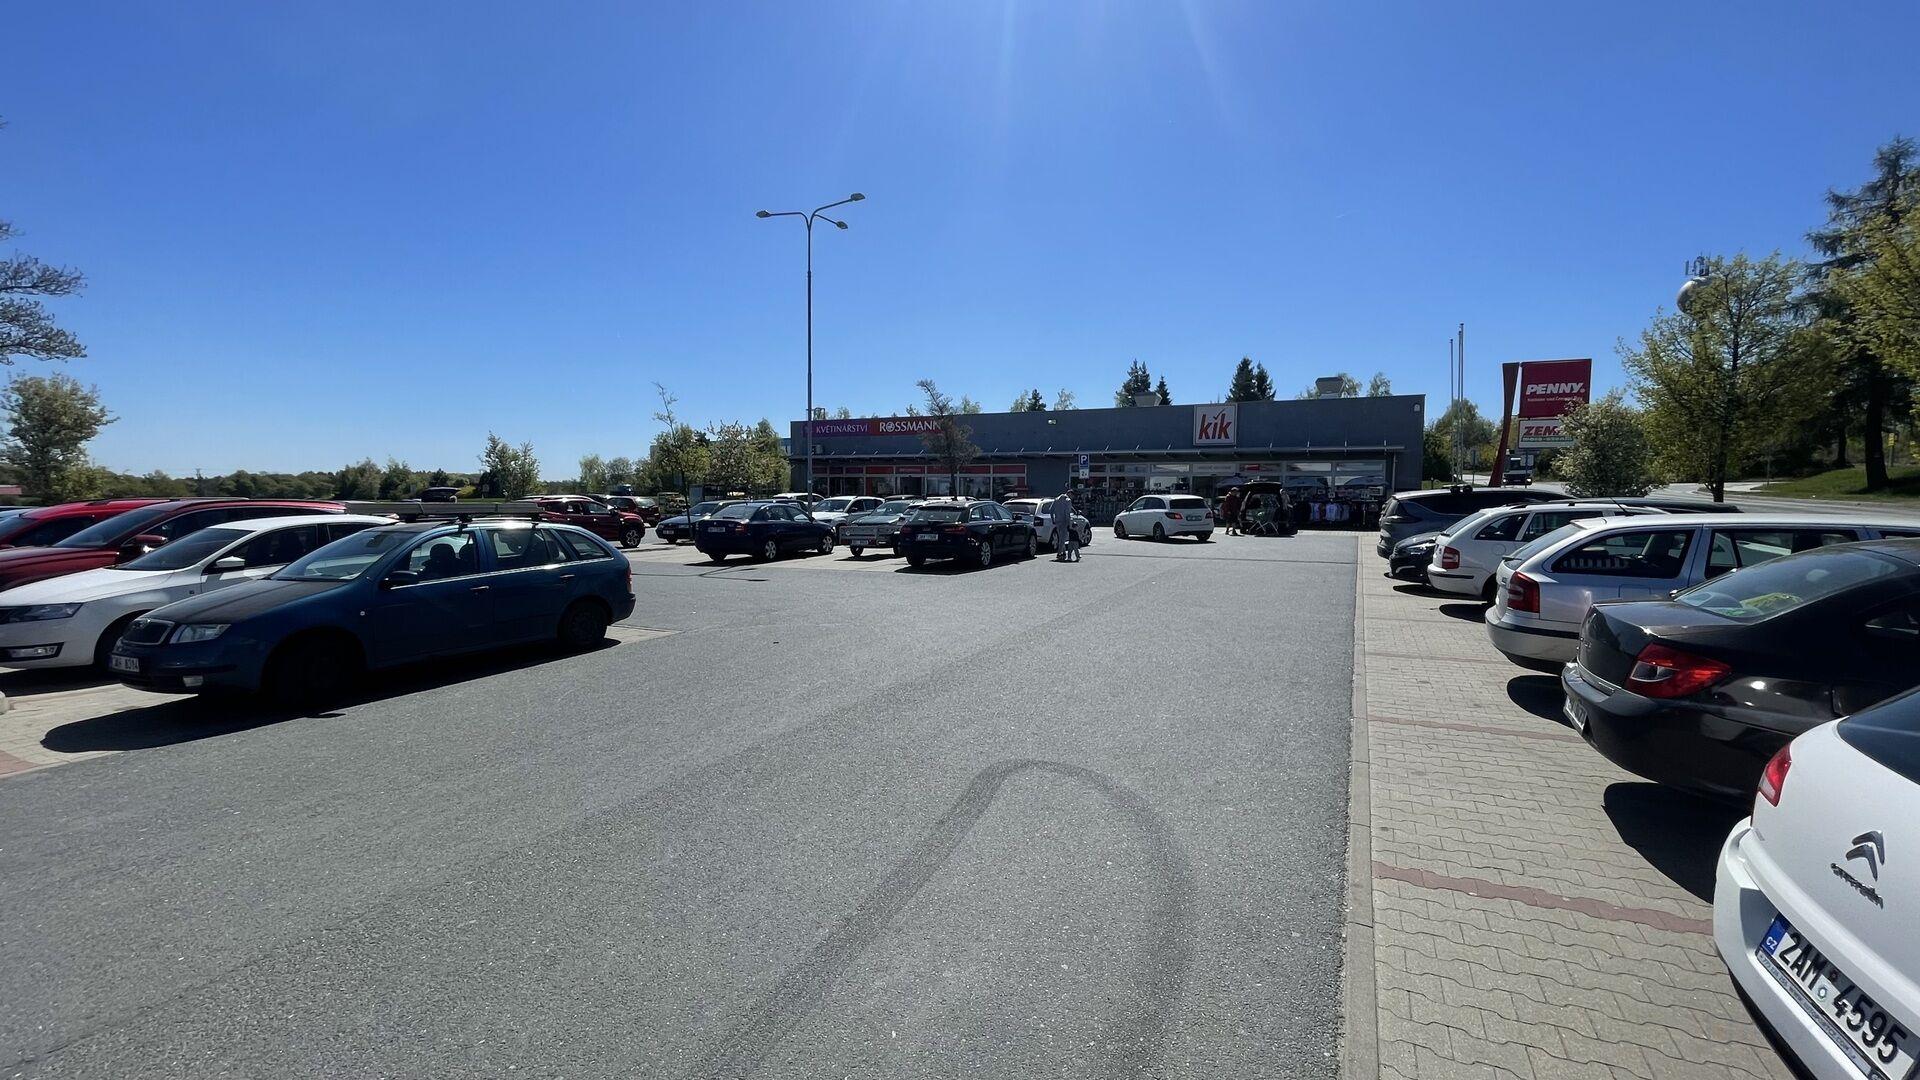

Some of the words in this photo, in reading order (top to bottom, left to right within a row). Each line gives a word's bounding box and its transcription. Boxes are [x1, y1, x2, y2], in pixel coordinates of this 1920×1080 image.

[1080, 455, 1087, 464] P
[1766, 936, 1778, 950] CZ
[1779, 932, 1827, 990] 2AM
[1834, 985, 1908, 1064] 4595
